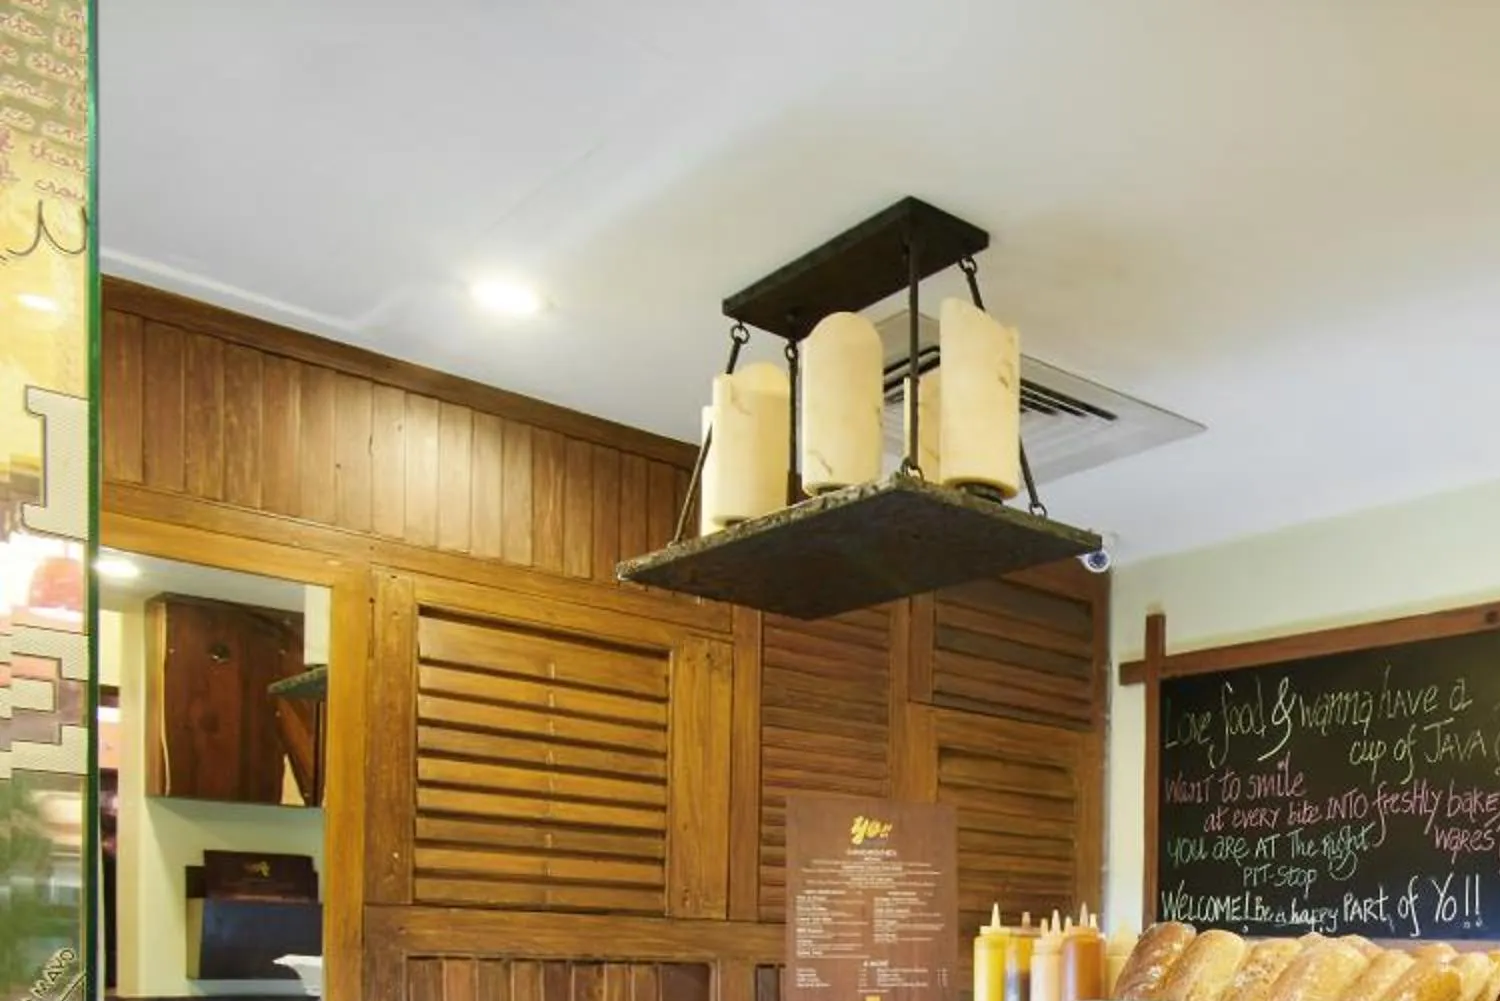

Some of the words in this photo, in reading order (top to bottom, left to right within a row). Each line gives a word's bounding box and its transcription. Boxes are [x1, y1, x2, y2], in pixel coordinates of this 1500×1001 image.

[1219, 676, 1267, 766] food
[1257, 676, 1297, 761] &
[1300, 689, 1373, 736] wanna
[1378, 664, 1438, 719] have
[1219, 769, 1242, 803] to
[1246, 750, 1306, 799] smile
[1350, 739, 1387, 783] cup
[1393, 723, 1416, 785] of
[1203, 806, 1229, 833] at
[1287, 799, 1322, 826] bite
[1327, 787, 1368, 821] INTO
[1255, 834, 1281, 859] AT
[1323, 821, 1376, 880] right
[1289, 897, 1339, 932] happy
[1397, 875, 1421, 937] of
[32, 949, 75, 998] MAYO
